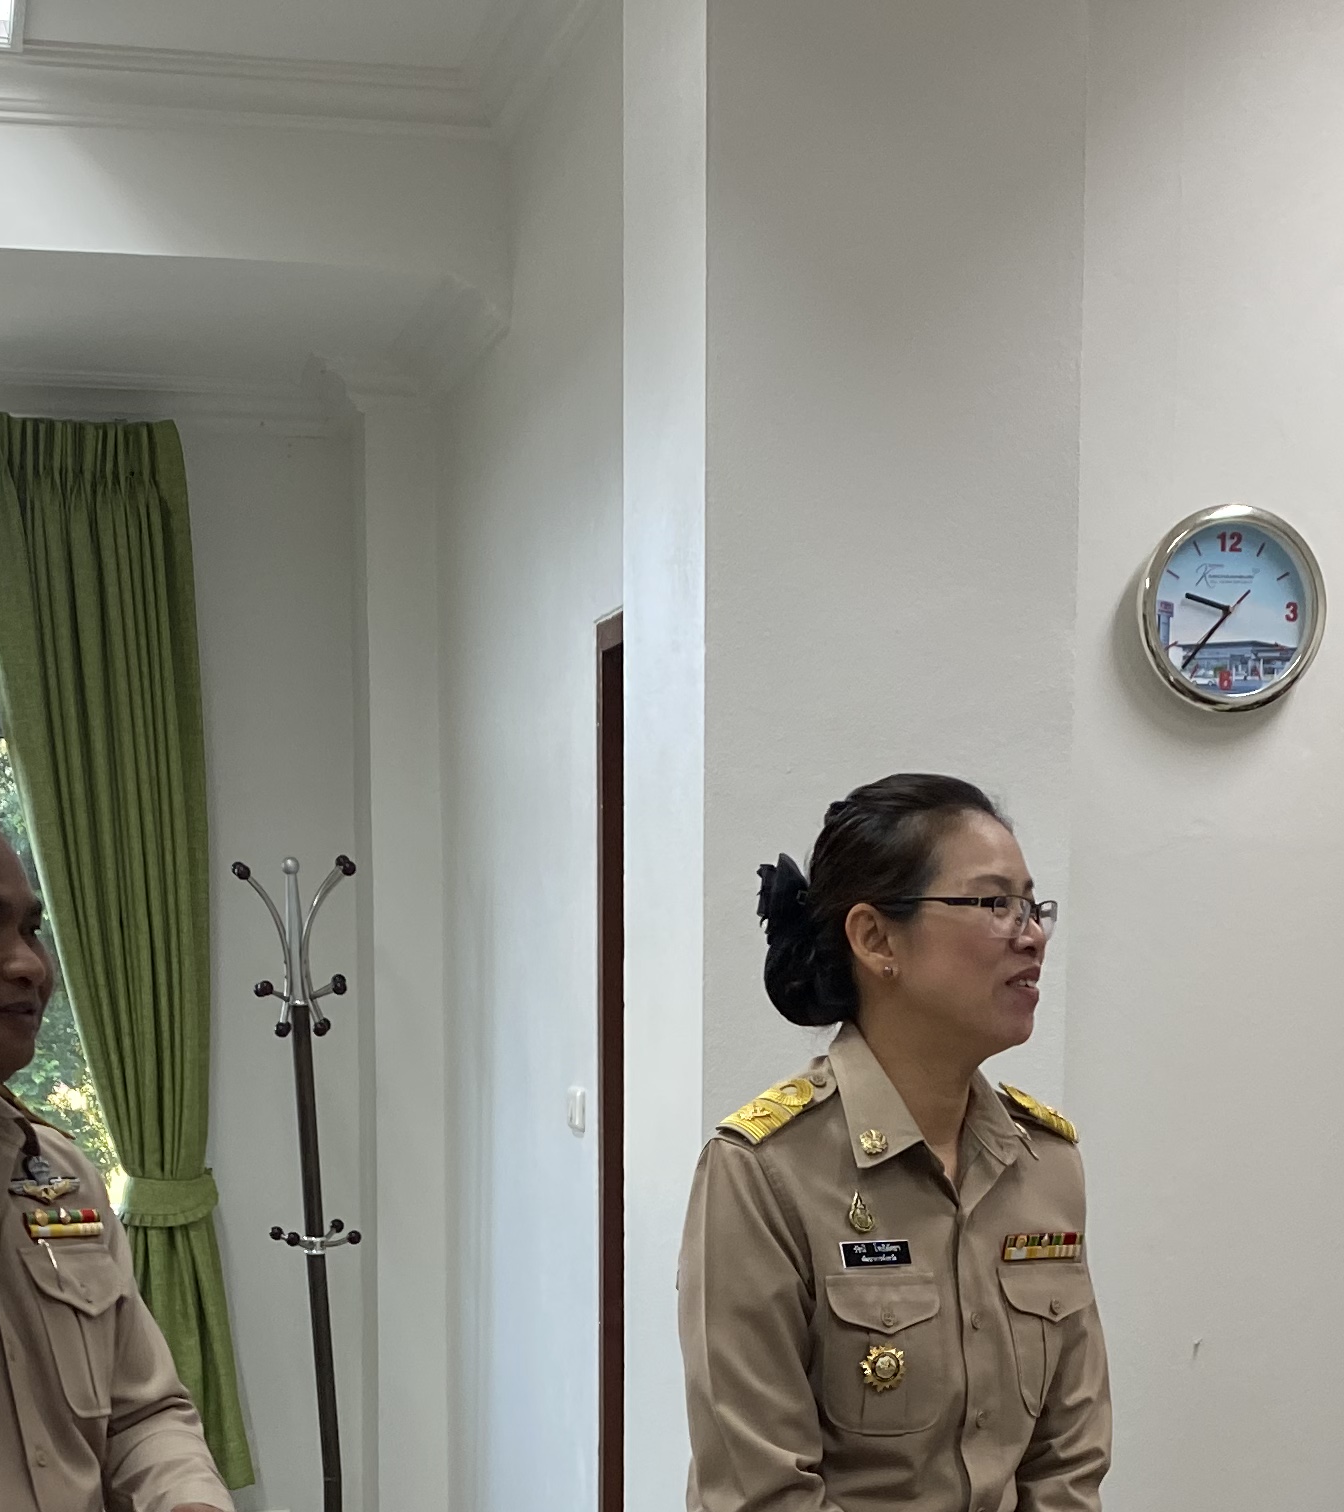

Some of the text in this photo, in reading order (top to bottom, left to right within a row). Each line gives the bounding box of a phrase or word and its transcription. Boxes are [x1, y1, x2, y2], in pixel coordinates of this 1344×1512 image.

[1217, 532, 1242, 553] 12
[1285, 602, 1298, 622] 3
[1218, 670, 1233, 690] 6
